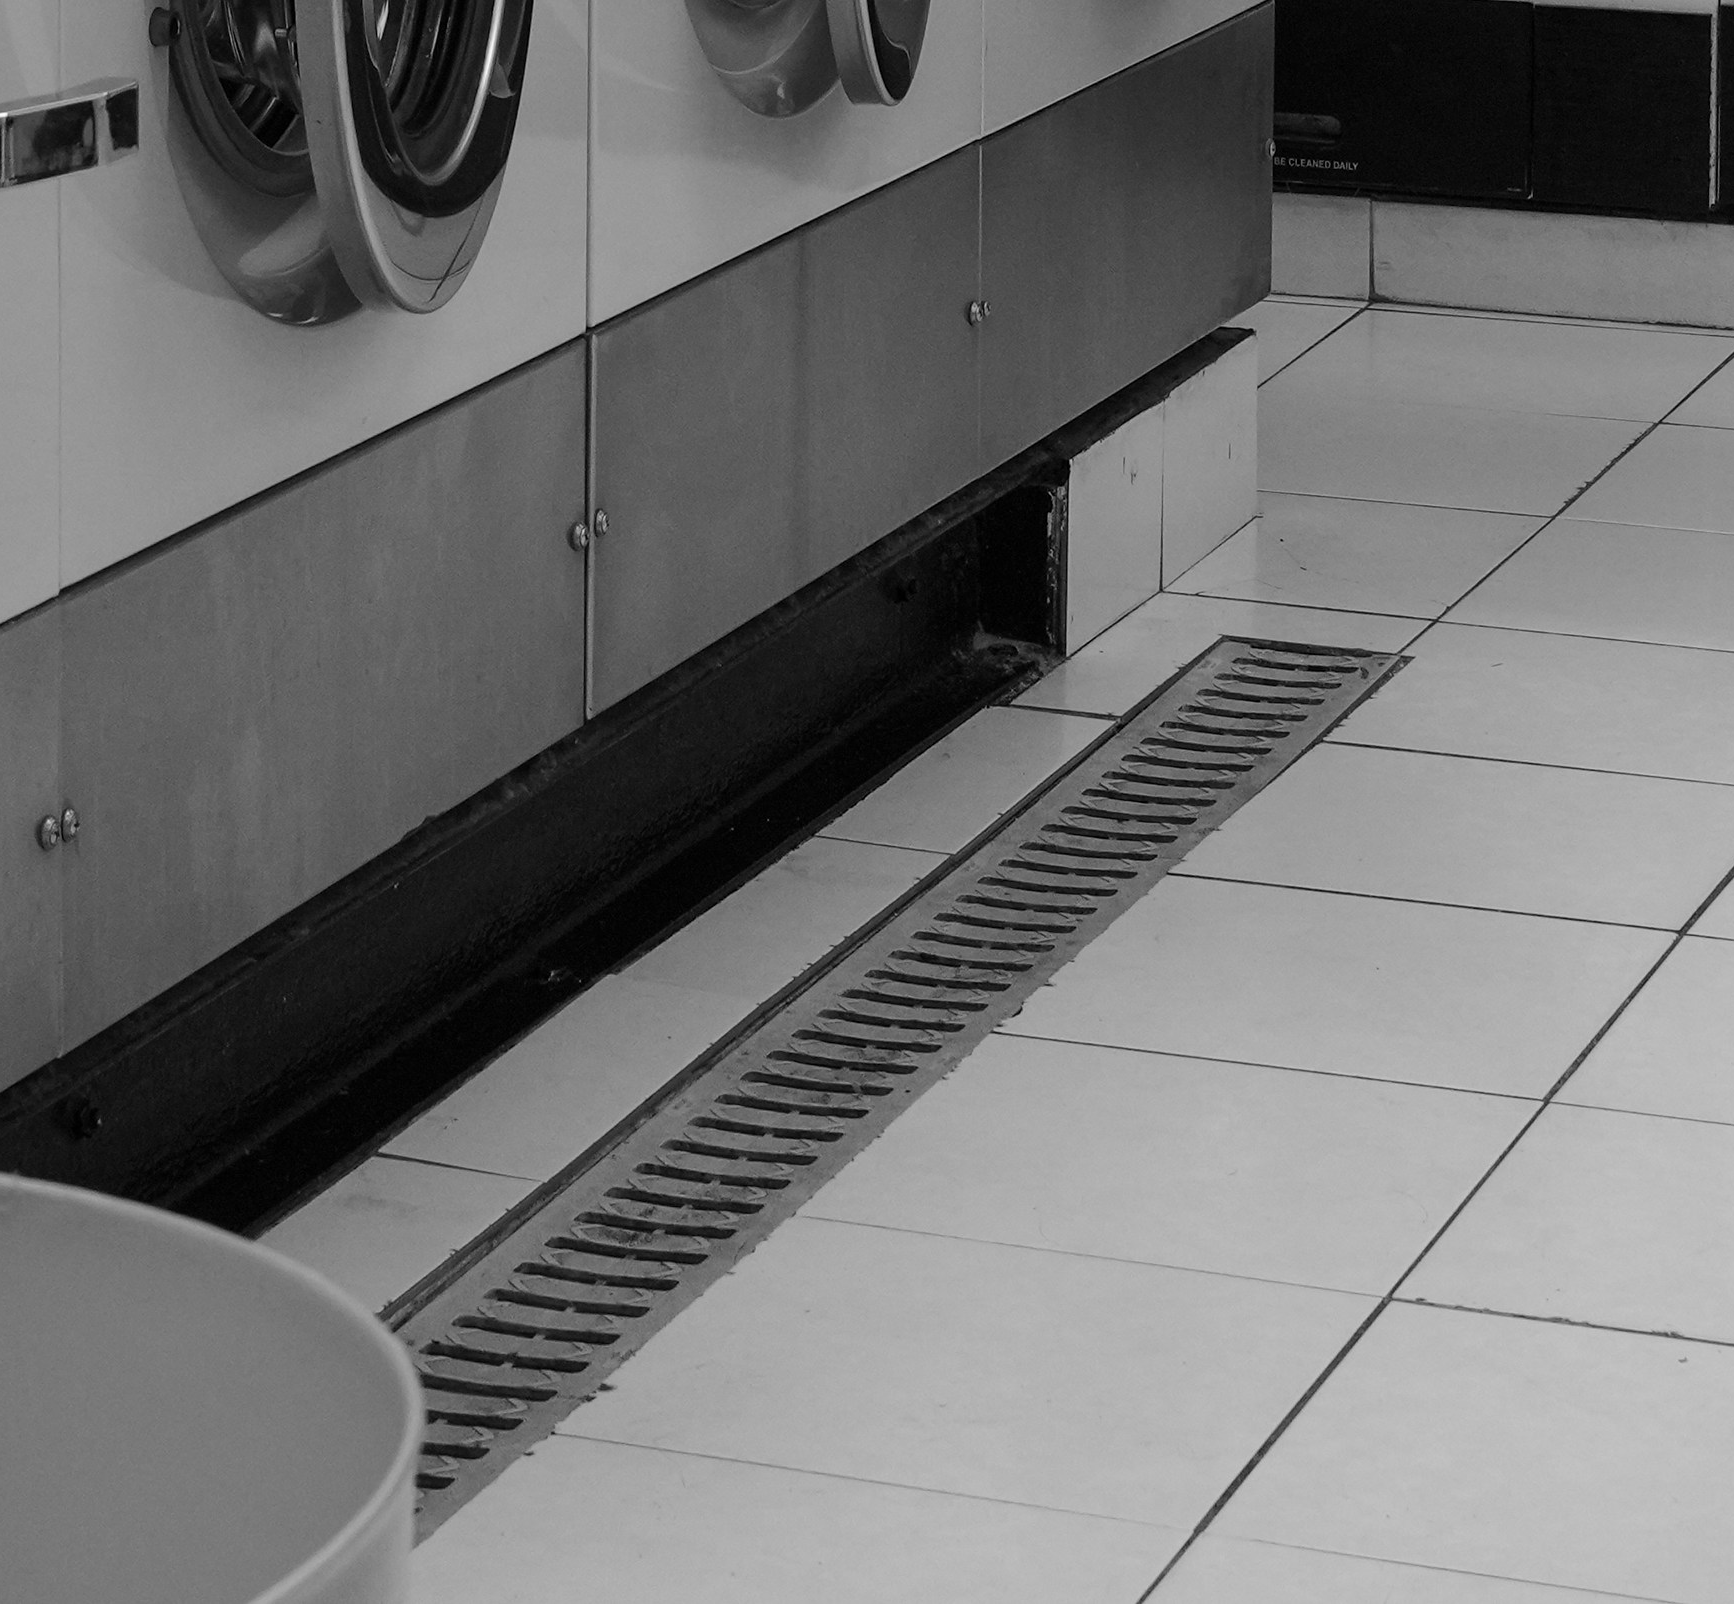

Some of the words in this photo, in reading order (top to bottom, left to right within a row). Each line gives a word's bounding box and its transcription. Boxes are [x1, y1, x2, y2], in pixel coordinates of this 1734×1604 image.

[1274, 157, 1285, 166] BE
[1288, 158, 1331, 169] CLEANED
[1333, 161, 1358, 170] DAILY
